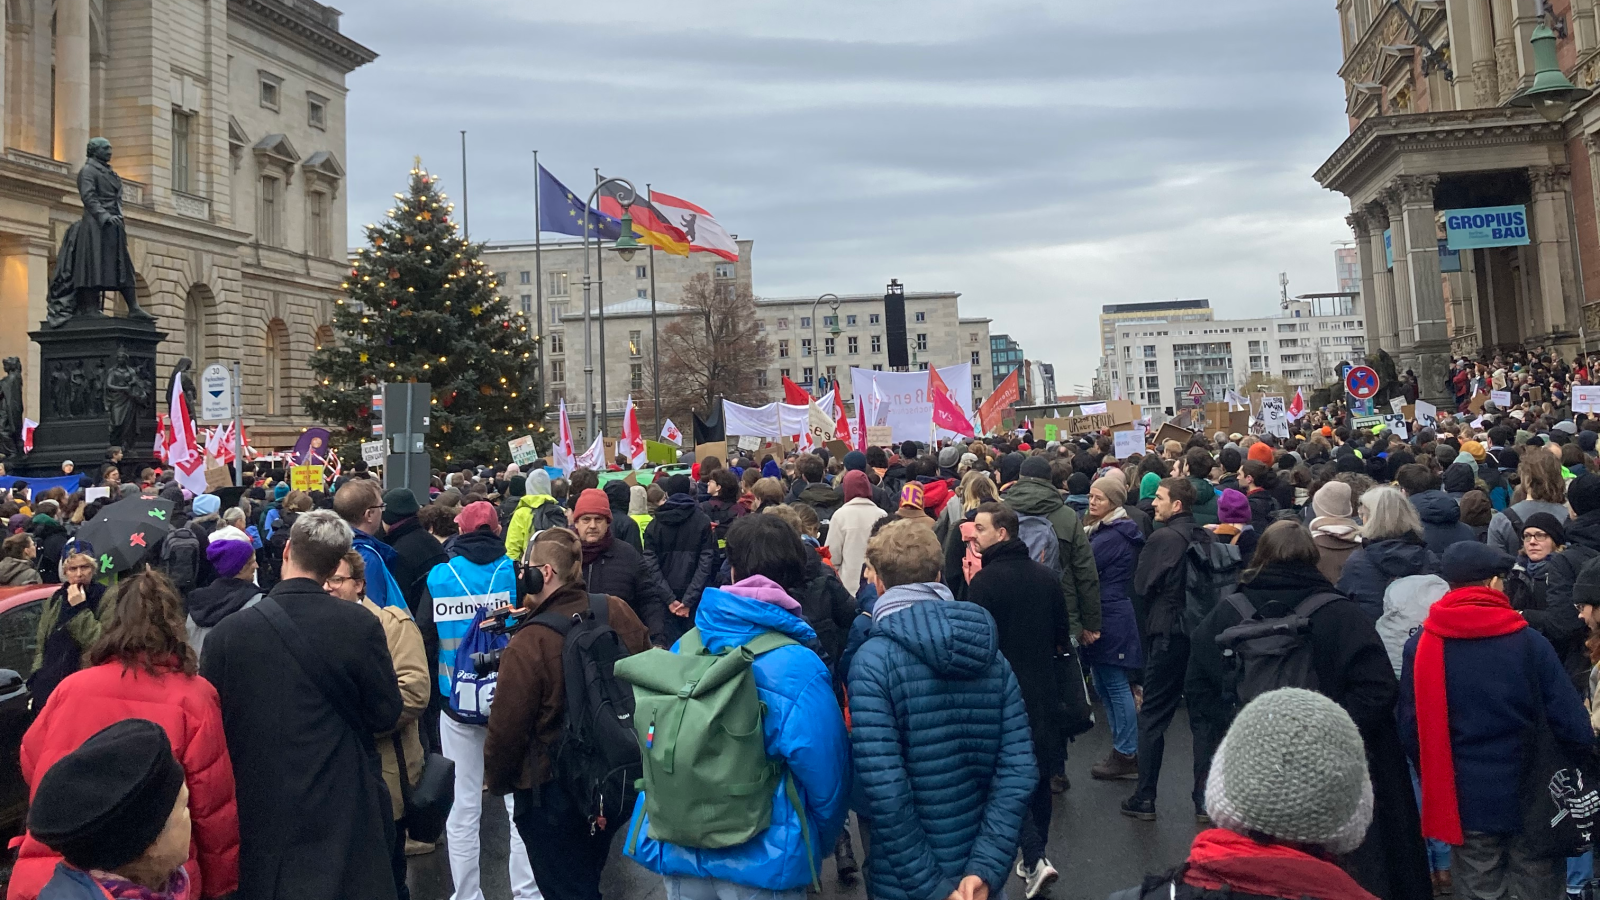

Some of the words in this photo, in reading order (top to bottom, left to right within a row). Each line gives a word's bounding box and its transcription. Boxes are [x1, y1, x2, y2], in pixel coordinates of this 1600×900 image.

[1447, 211, 1525, 231] GROPIUS
[1491, 226, 1526, 239] BAU
[212, 367, 220, 375] 30
